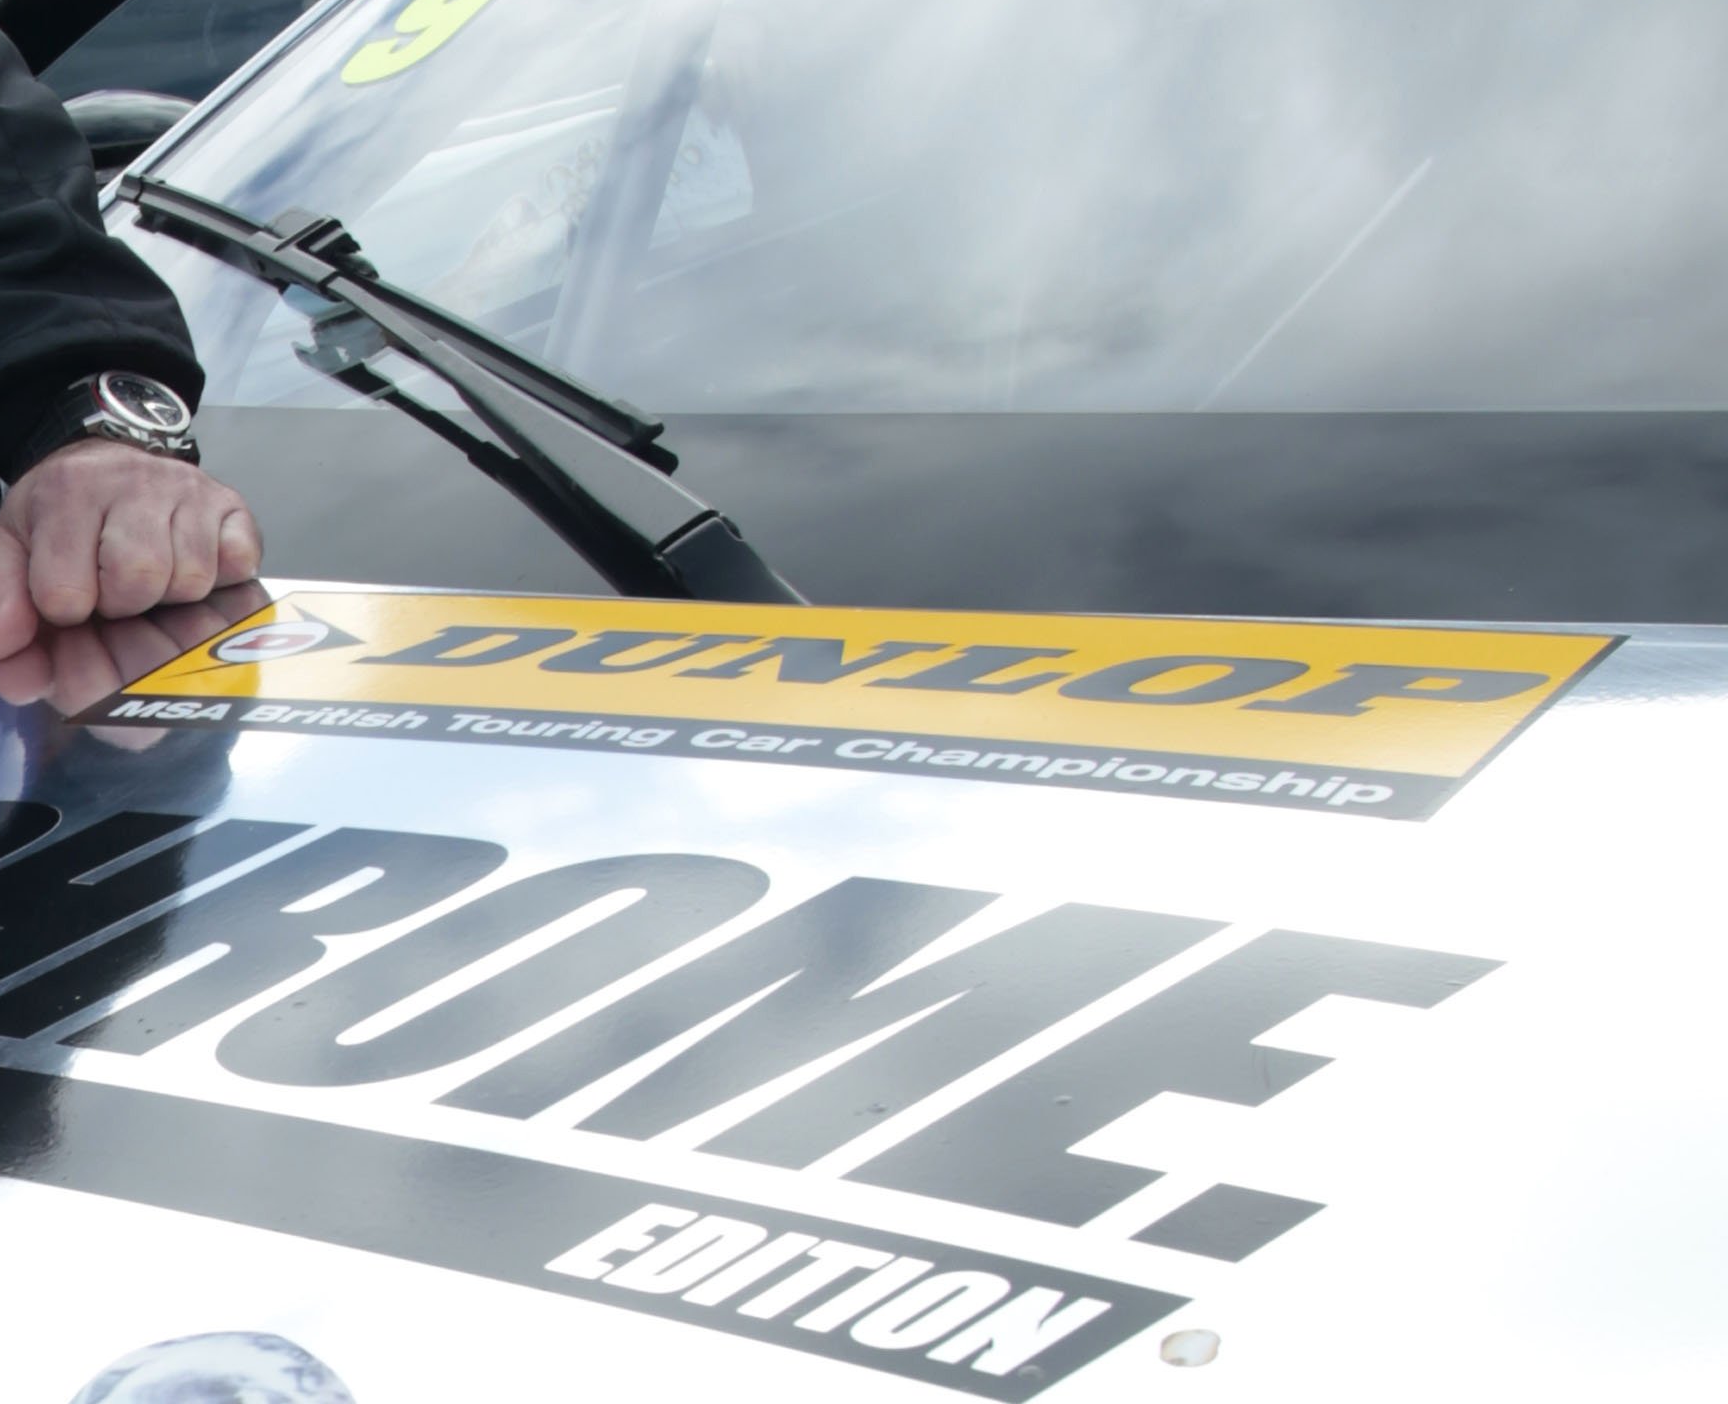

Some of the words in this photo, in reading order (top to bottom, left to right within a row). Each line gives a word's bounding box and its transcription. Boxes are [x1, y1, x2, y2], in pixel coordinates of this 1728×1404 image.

[350, 624, 1551, 718] DUNLOP
[108, 700, 232, 722] MSA
[240, 703, 429, 731] British
[444, 711, 677, 748] Touring
[688, 728, 822, 759] Car
[835, 736, 1394, 808] Championship
[544, 1203, 1112, 1377] EDITION
